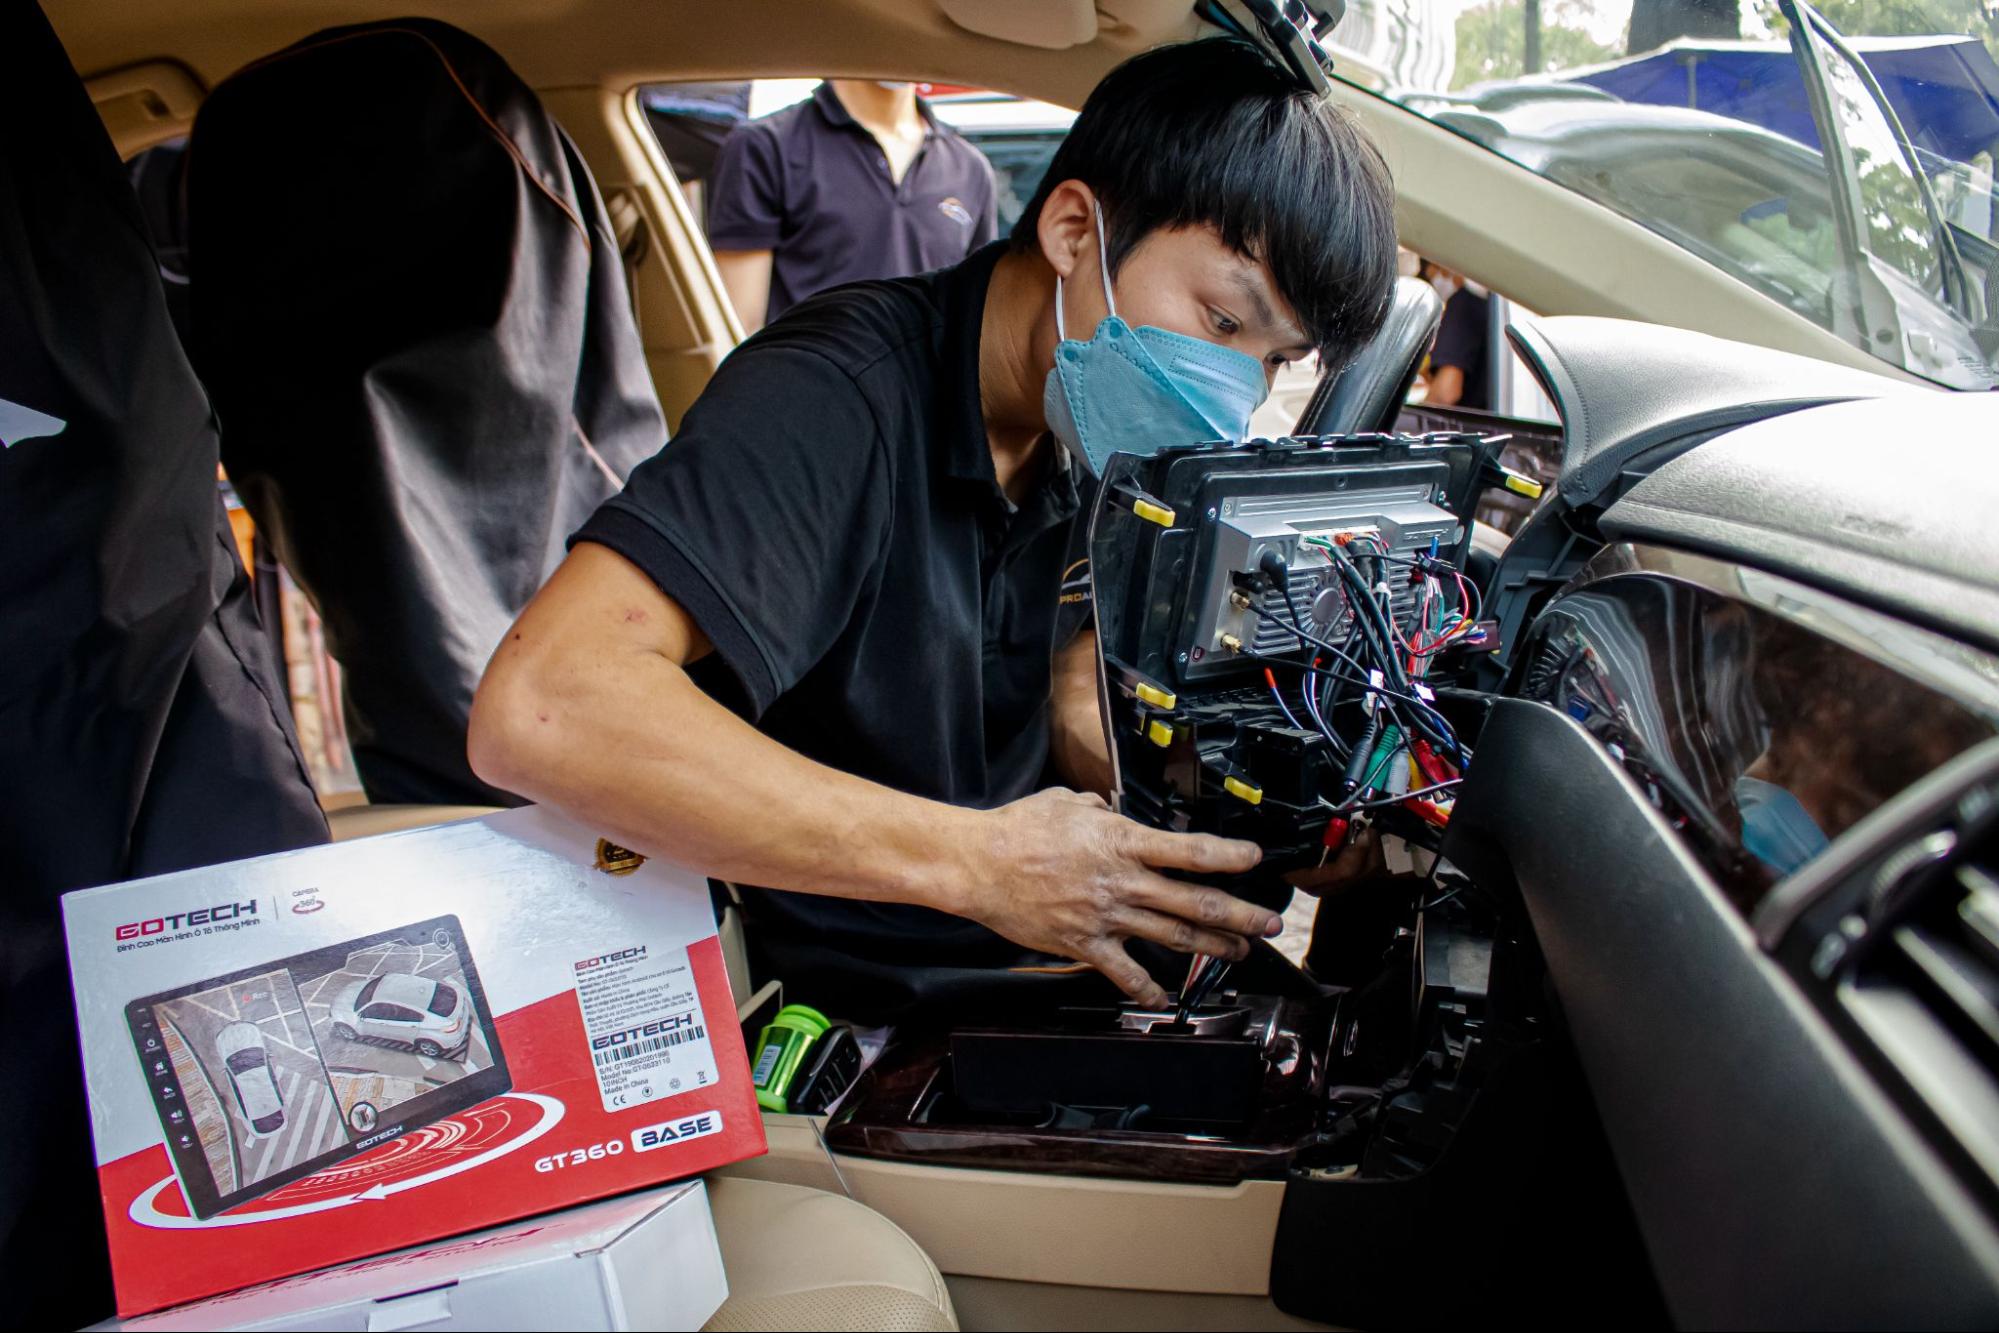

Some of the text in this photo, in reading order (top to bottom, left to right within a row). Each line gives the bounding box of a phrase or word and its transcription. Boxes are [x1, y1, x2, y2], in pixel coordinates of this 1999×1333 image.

[115, 899, 258, 941] GOTECH
[137, 940, 155, 948] Cao
[575, 945, 647, 970] GOTECH
[592, 1013, 693, 1050] GOTECH
[534, 1115, 713, 1173] GT360 BASE
